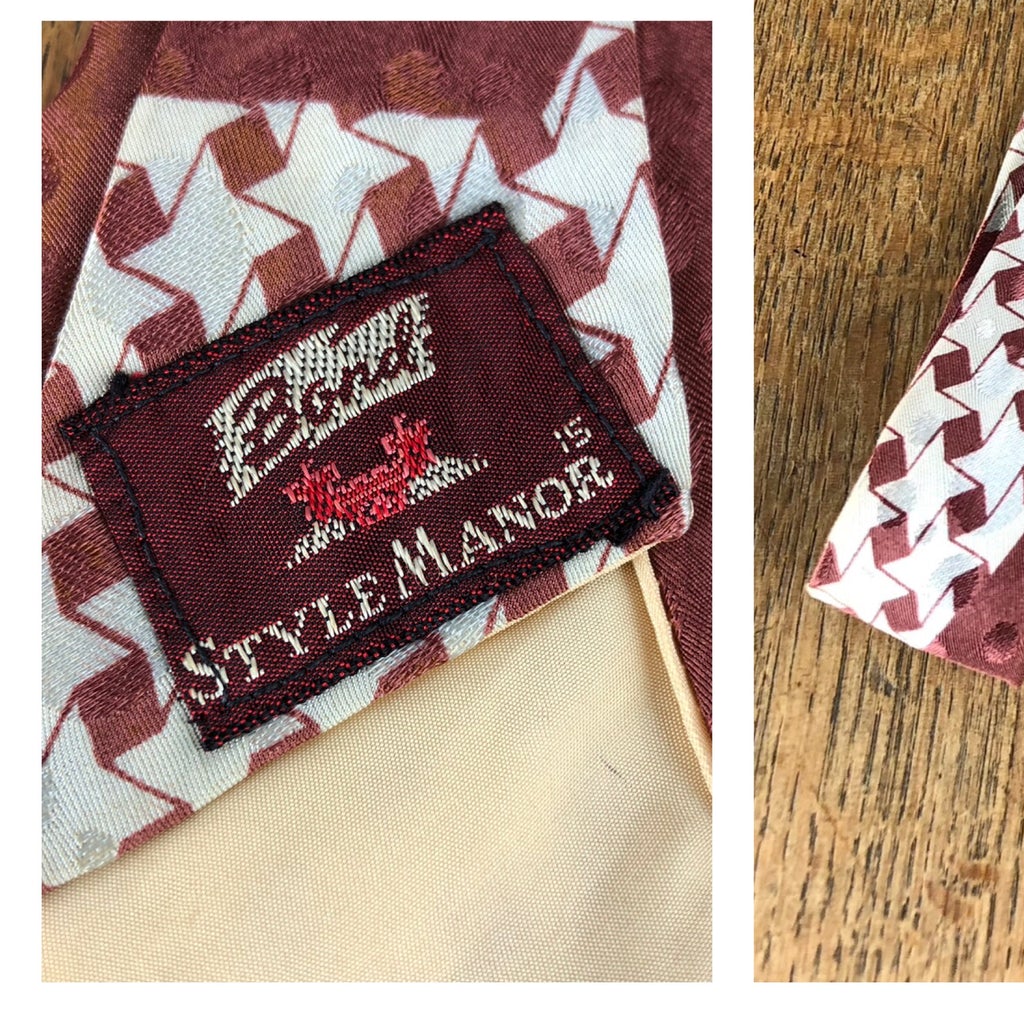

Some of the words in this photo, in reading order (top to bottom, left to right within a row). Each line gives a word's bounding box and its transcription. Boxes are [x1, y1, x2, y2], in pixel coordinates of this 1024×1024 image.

[230, 304, 418, 478] Bond
[182, 572, 386, 706] STYLE
[391, 456, 615, 599] MANOR
